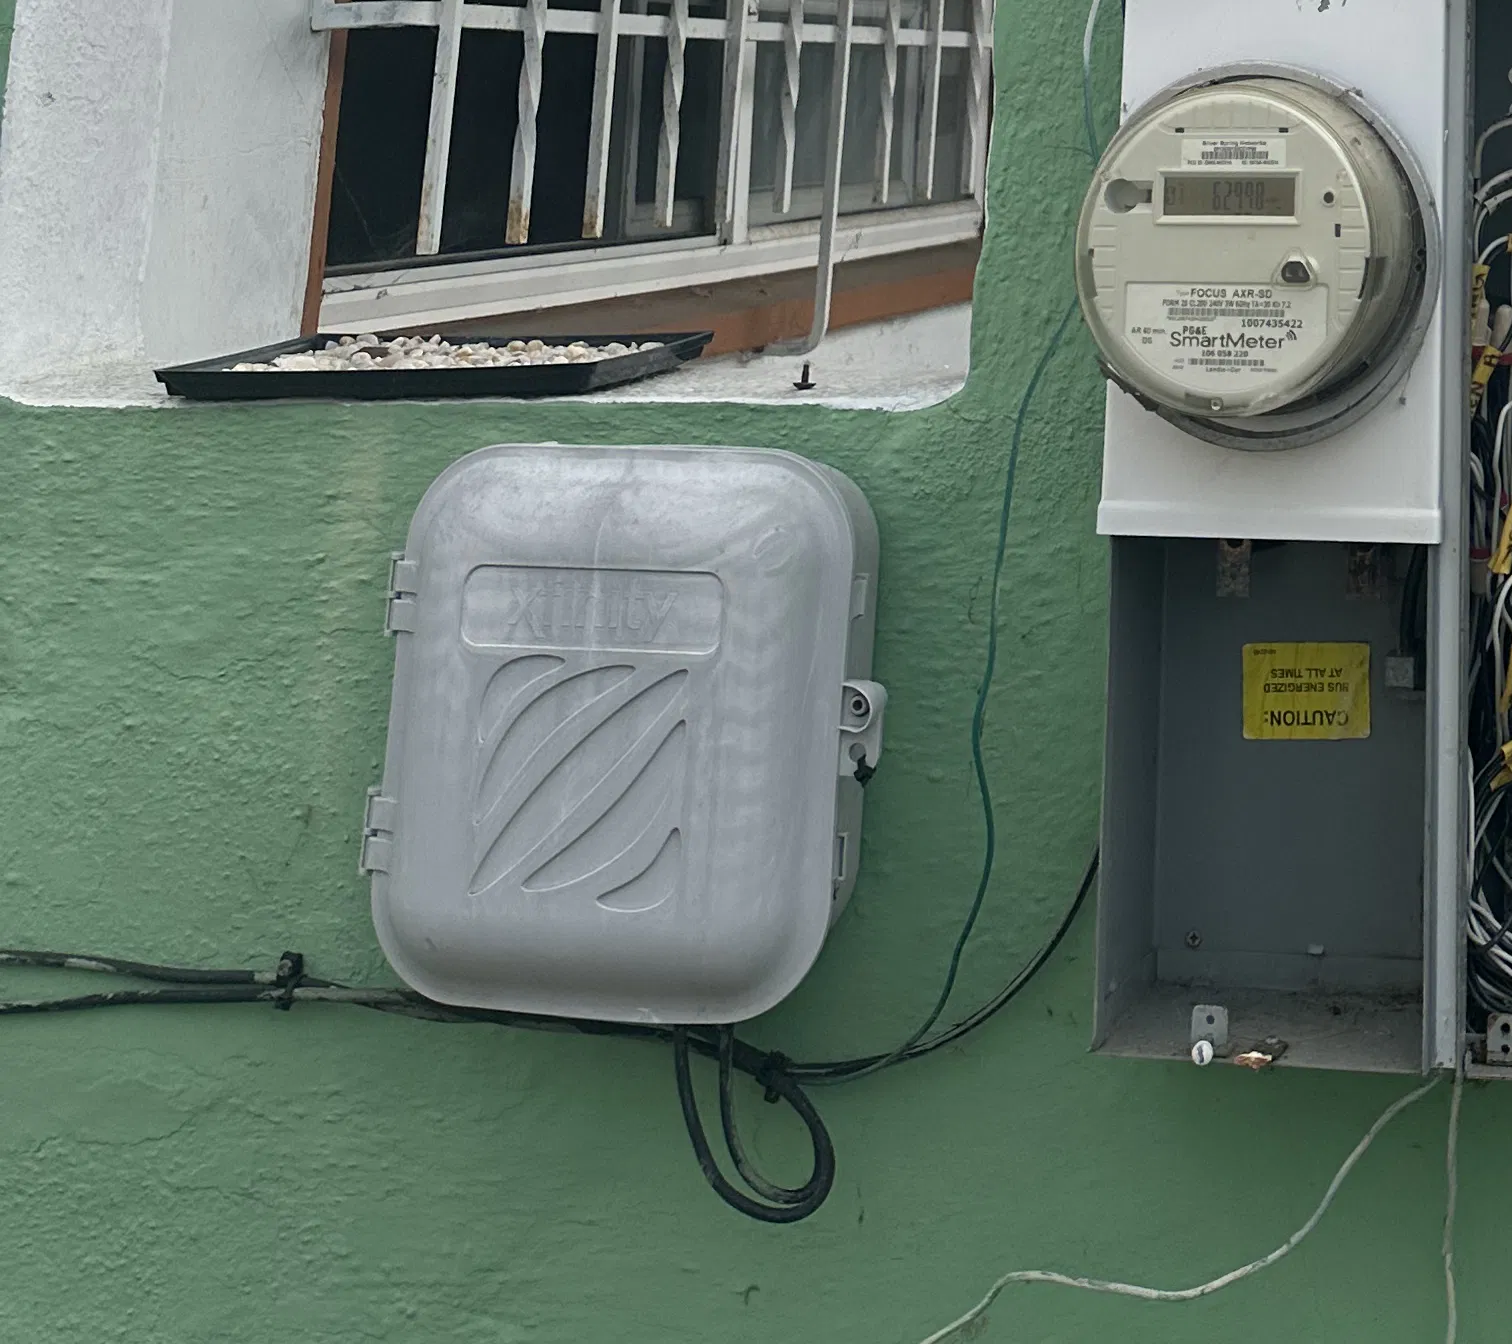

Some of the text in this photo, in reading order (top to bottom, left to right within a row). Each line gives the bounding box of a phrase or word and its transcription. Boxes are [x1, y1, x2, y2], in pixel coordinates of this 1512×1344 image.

[1190, 288, 1227, 298] FOCUS
[1232, 289, 1273, 299] AXR-SD
[1241, 319, 1303, 329] 1007435422
[1182, 326, 1208, 335] PG&E
[1169, 331, 1285, 349] SmartMeter
[1270, 667, 1343, 679] AT ALL TIMES
[1263, 682, 1325, 693] ENERGIZED
[1264, 710, 1349, 727] CAUTION:
